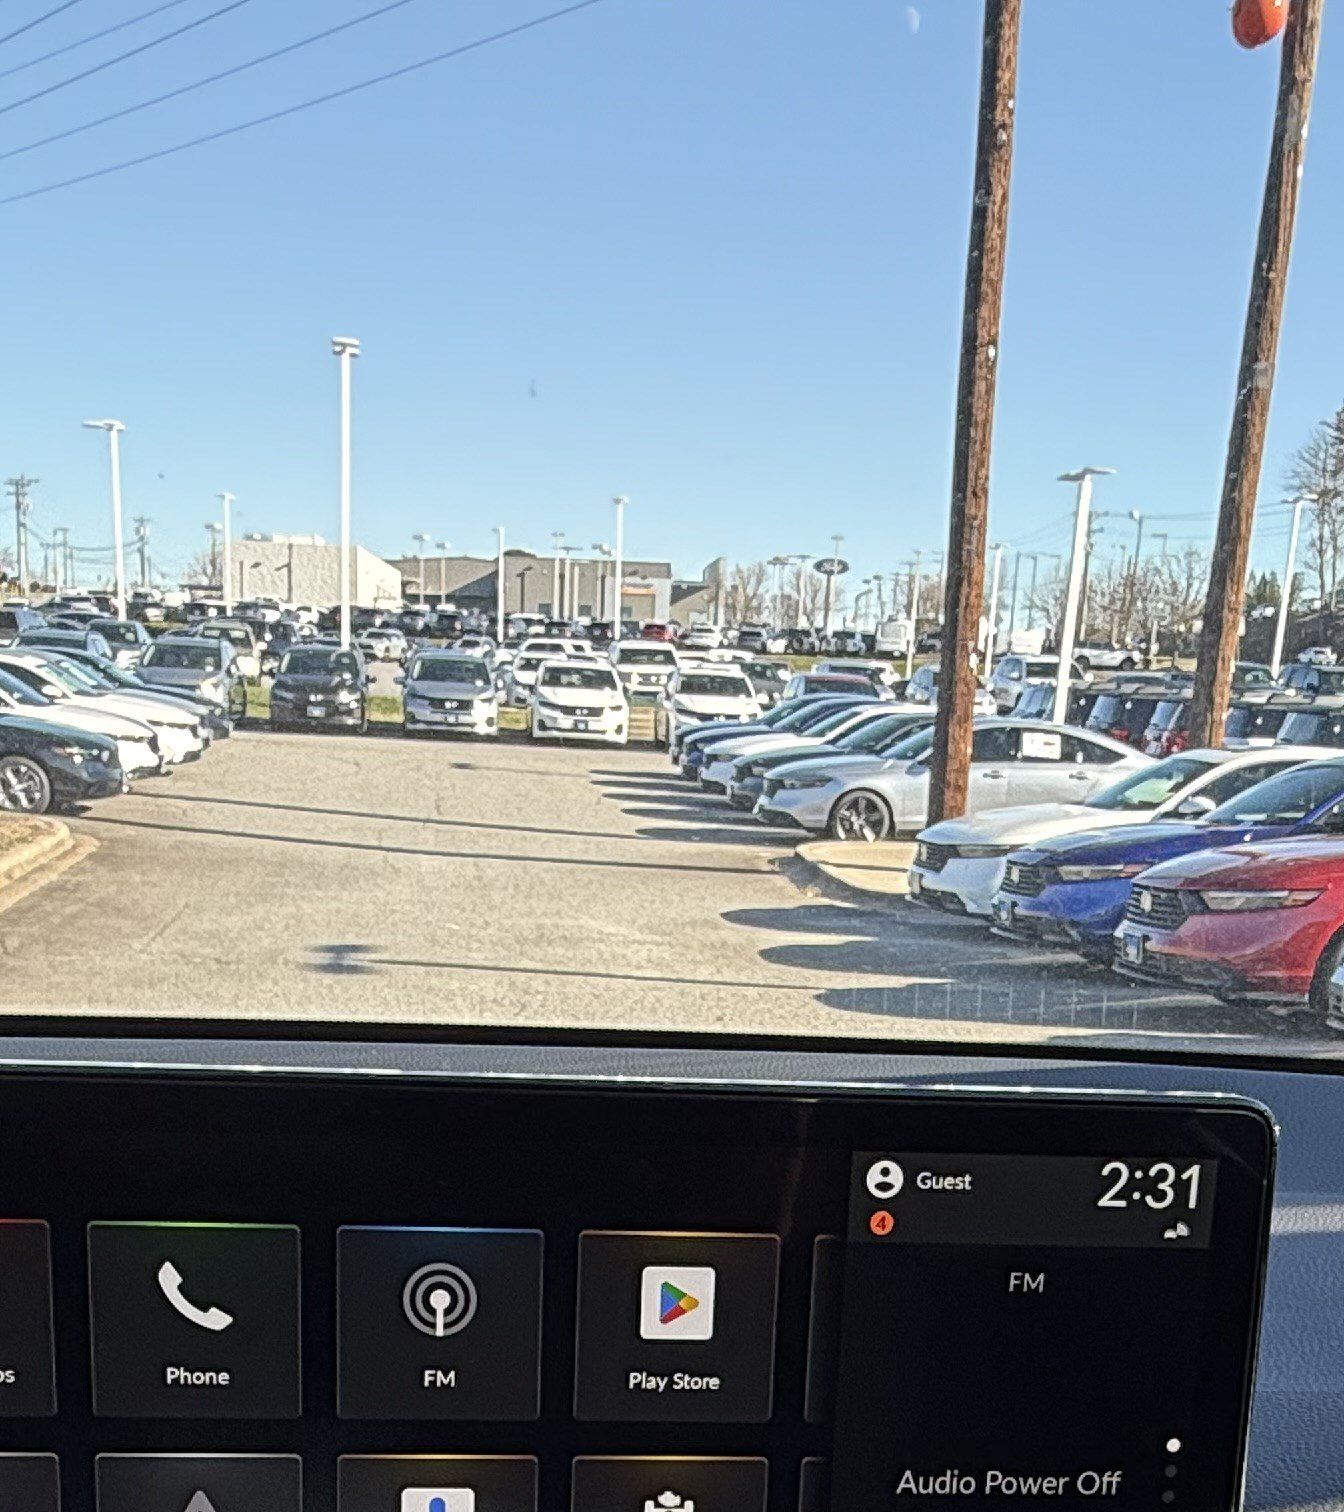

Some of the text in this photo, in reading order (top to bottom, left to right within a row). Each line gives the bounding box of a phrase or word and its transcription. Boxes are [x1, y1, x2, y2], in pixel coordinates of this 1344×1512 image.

[916, 1163, 1202, 1211] Guest 2:31
[875, 1214, 888, 1232] 4
[1008, 1272, 1045, 1294] FM
[165, 1366, 230, 1388] Phone
[423, 1369, 456, 1389] FM
[628, 1371, 721, 1395] Play Store
[896, 1468, 1122, 1497] Audio Power Off
